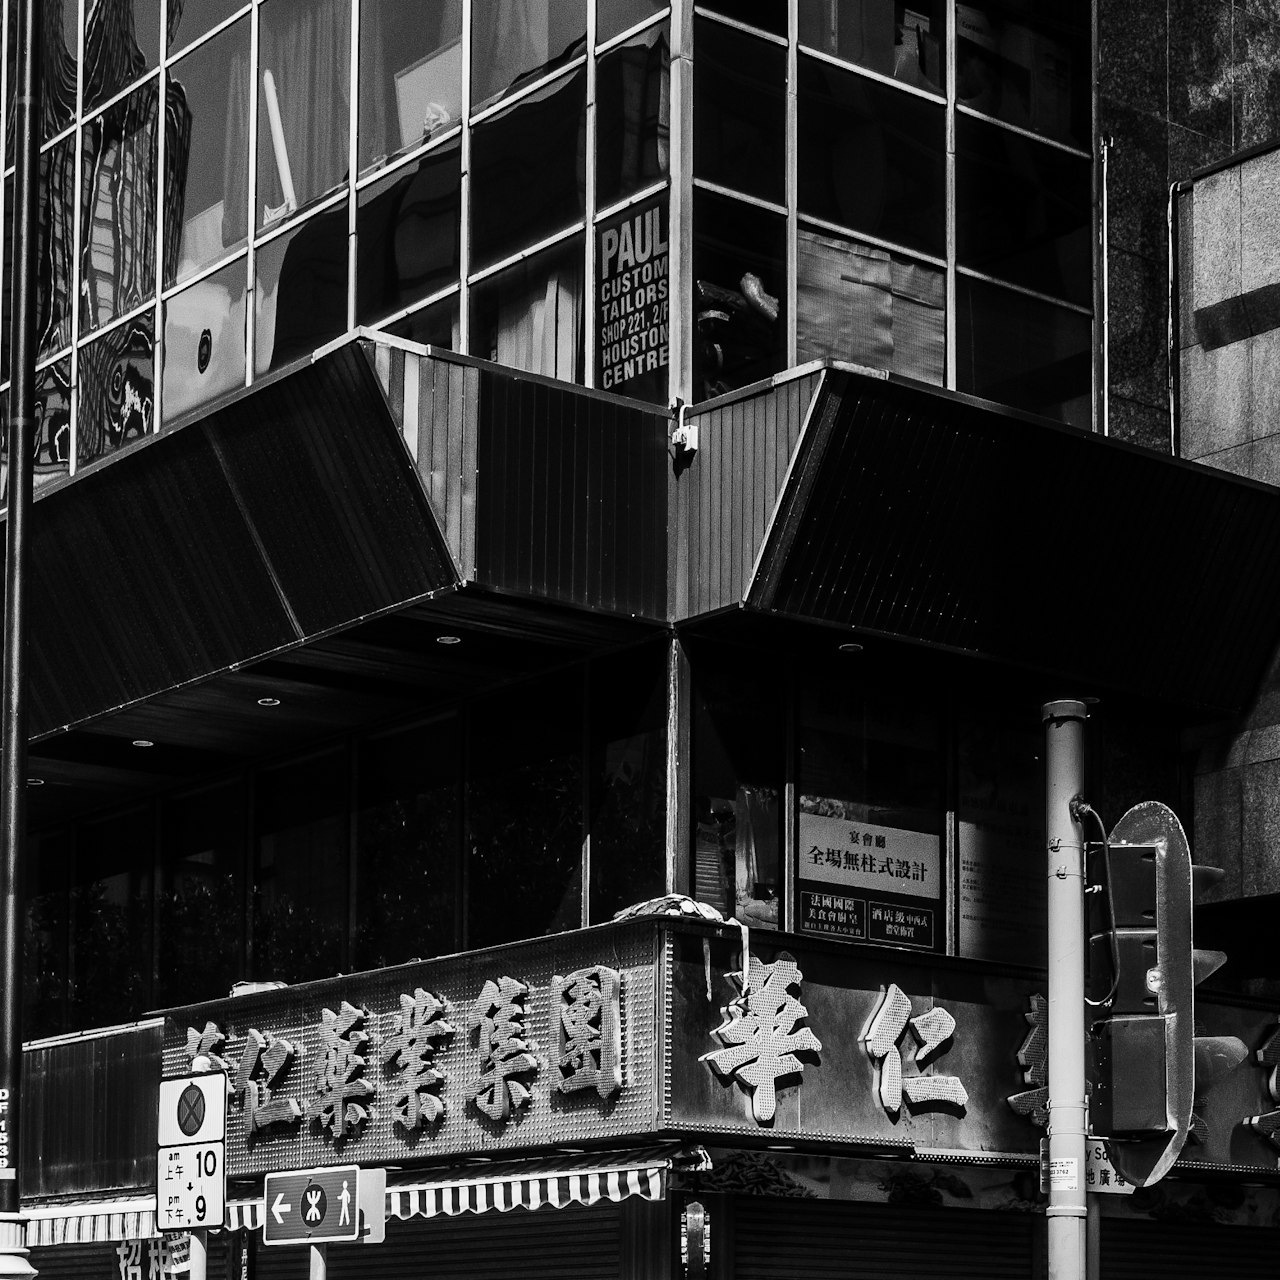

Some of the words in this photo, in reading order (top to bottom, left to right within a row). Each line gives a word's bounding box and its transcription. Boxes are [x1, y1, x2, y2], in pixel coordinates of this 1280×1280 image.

[601, 206, 669, 280] PAUL
[601, 256, 670, 302] CUSTOM
[601, 279, 669, 325] TAILORS
[601, 318, 626, 347] SHOP
[627, 312, 650, 337] 221,
[601, 322, 670, 368] HOUSTON
[602, 345, 670, 390] CENTRE
[849, 831, 886, 849] 宴會廳
[807, 845, 928, 882] 全場無柱式設計
[164, 1164, 184, 1182] 上午
[168, 1151, 180, 1162] am
[195, 1149, 217, 1178] 10
[164, 1207, 184, 1225] 下午
[168, 1195, 181, 1206] pm
[195, 1195, 207, 1222] 9
